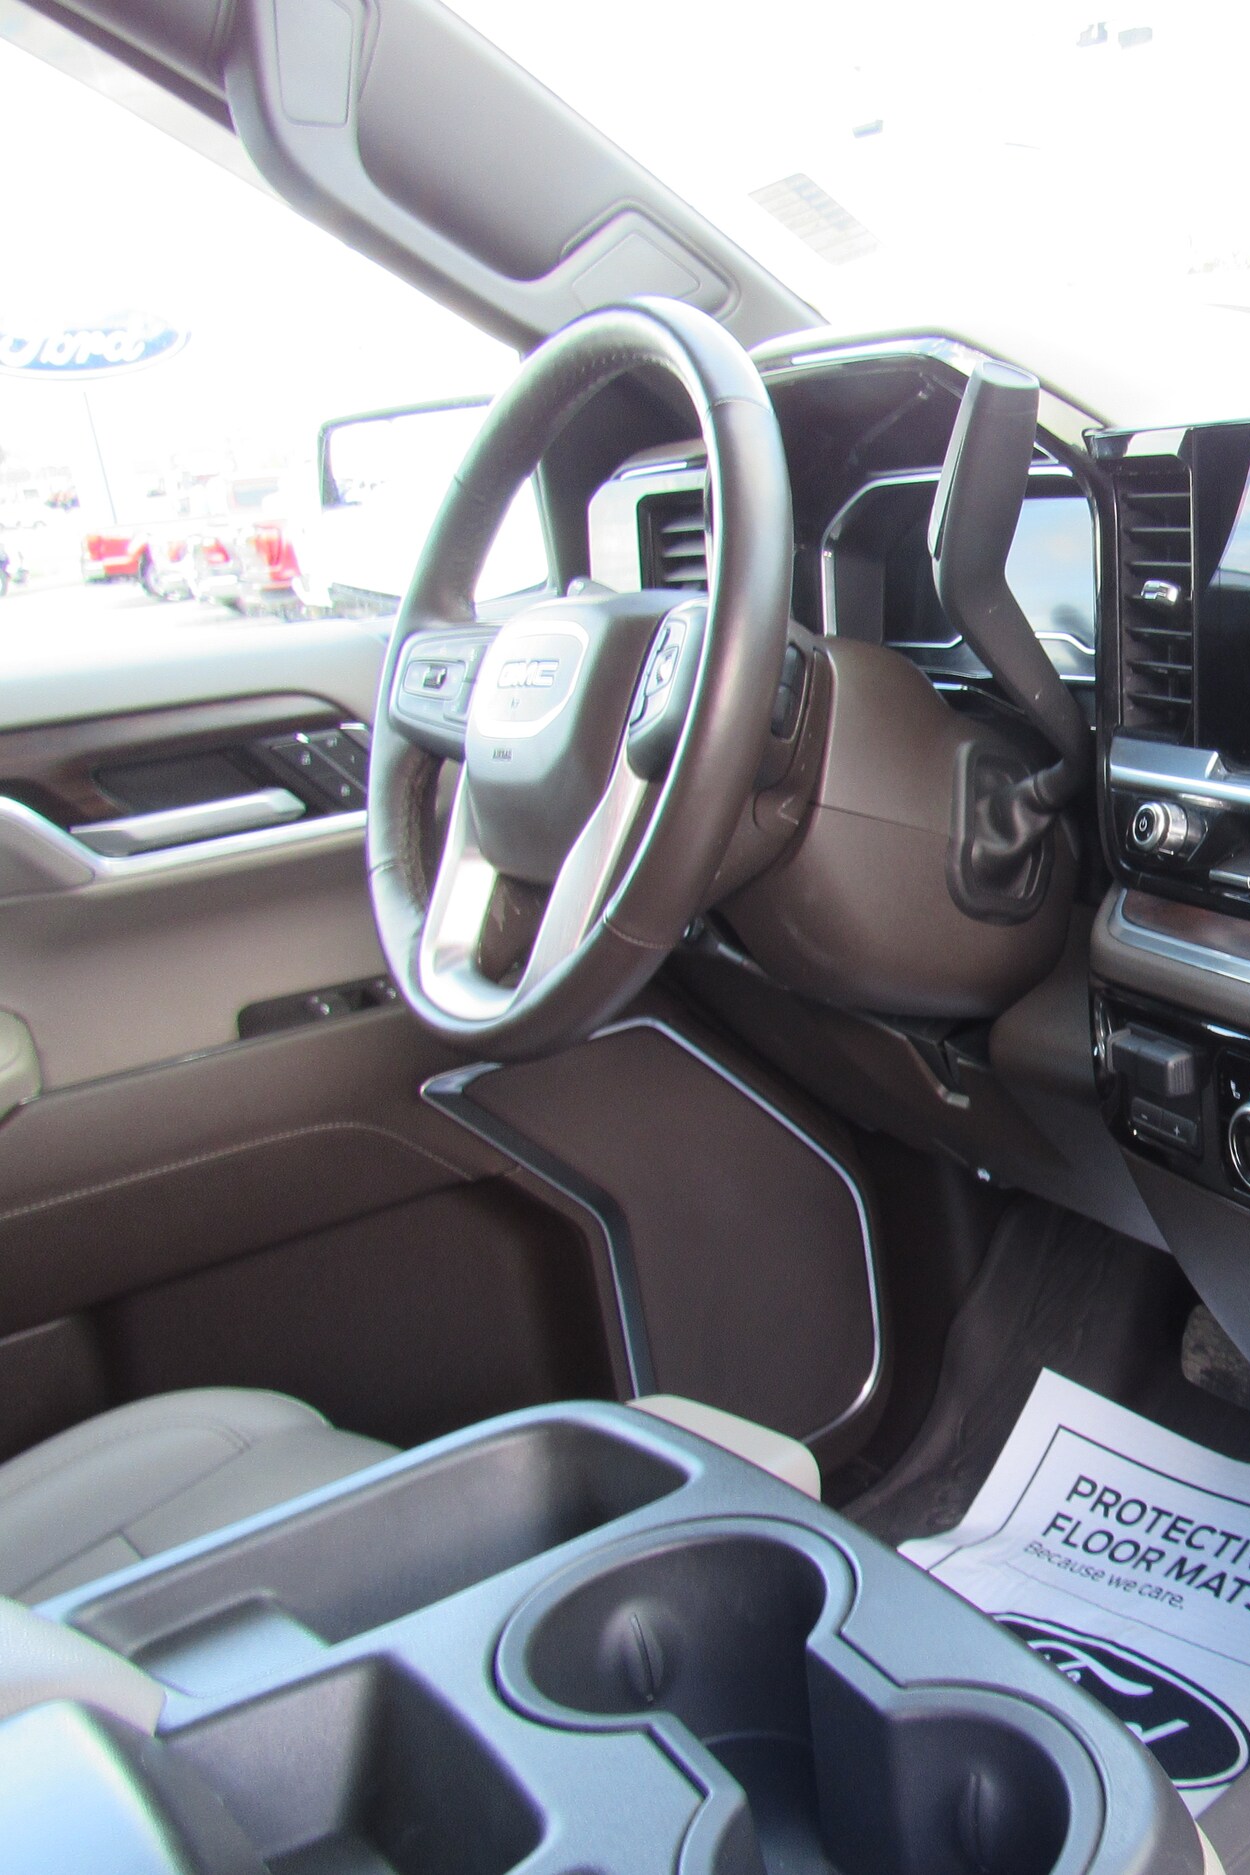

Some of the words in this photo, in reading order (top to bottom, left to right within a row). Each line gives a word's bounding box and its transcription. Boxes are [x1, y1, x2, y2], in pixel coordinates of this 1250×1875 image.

[496, 659, 560, 688] GMC
[1042, 1512, 1166, 1573] FLOOR
[1024, 1540, 1106, 1581] Because
[1108, 1572, 1138, 1593] we
[1138, 1581, 1184, 1610] care.
